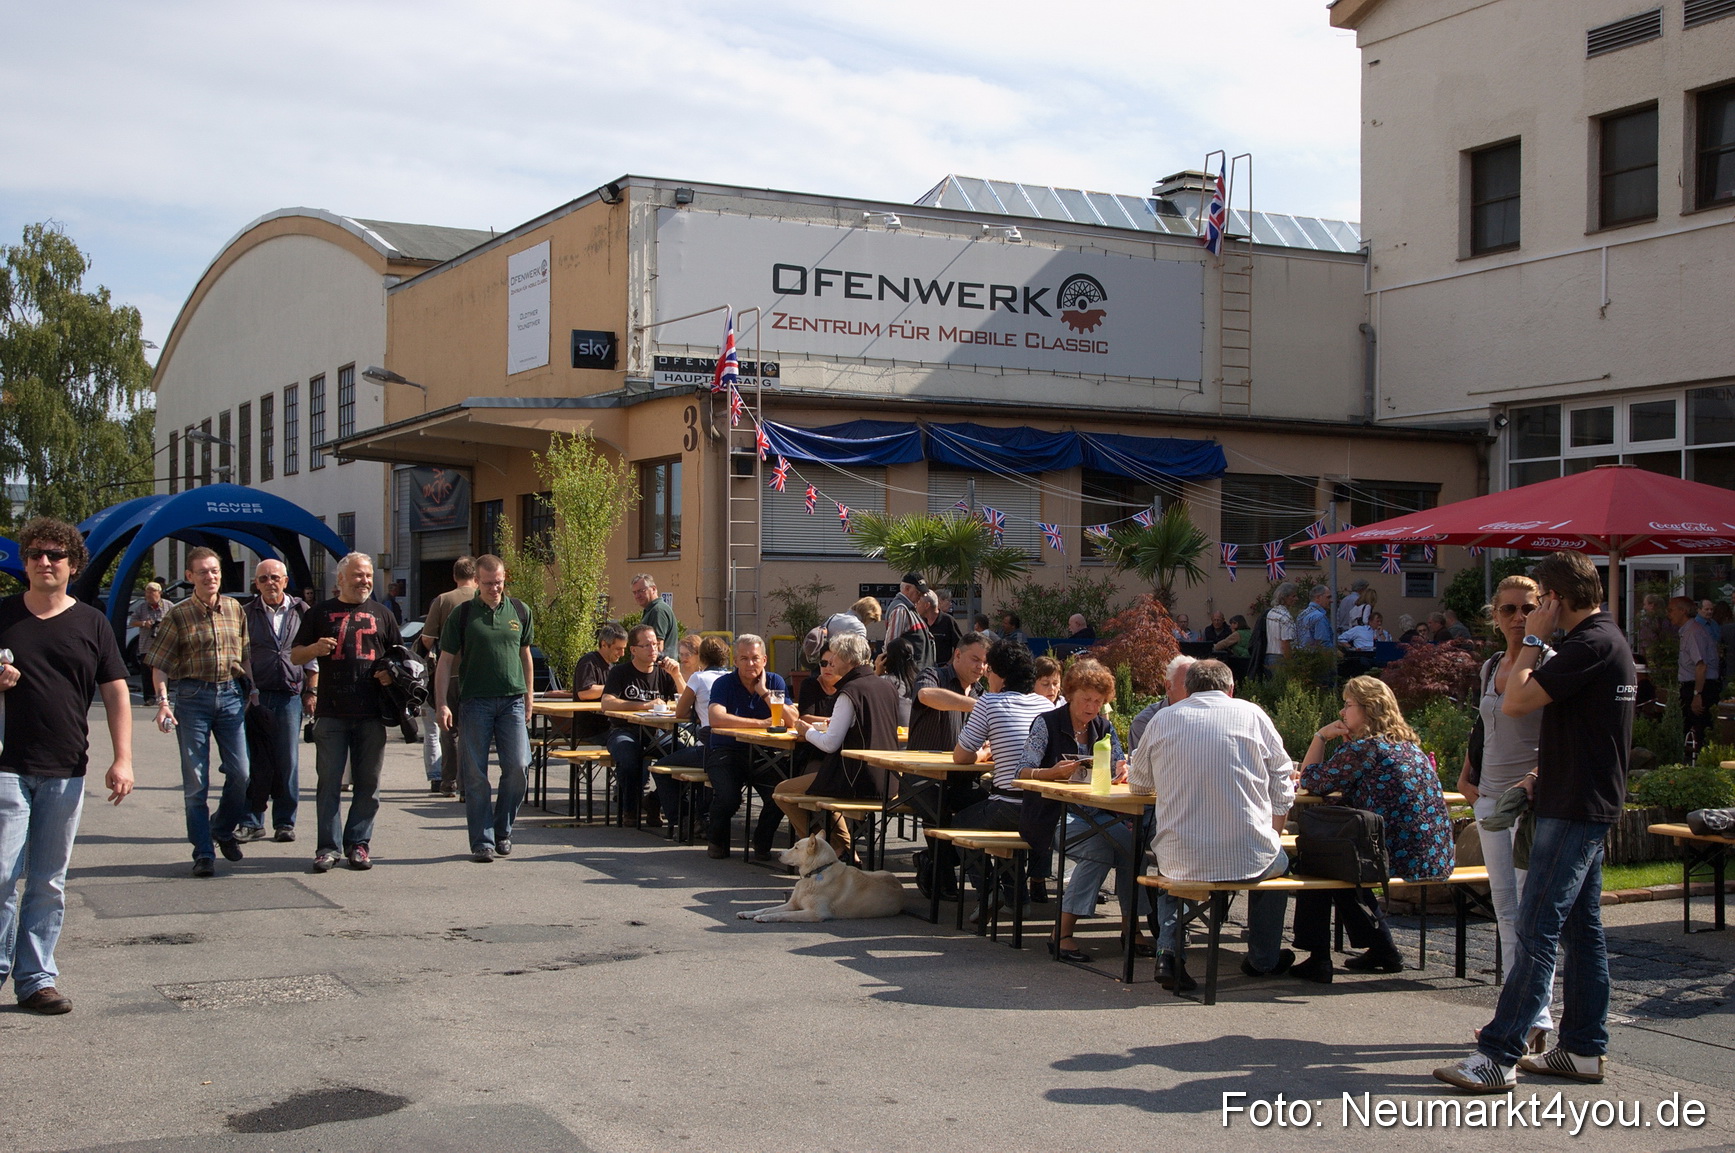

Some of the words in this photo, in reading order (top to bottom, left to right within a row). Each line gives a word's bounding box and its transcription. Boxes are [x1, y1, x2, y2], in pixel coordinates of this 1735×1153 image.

[772, 262, 1053, 318] OFENWERK
[579, 339, 610, 360] sky
[771, 312, 881, 337] ZENTRUM
[888, 320, 930, 341] FÜR
[938, 325, 1017, 348] MOBILE
[1025, 332, 1109, 355] CLASSIC
[683, 405, 699, 452] 3
[1649, 521, 1718, 532] Coca-Cola
[328, 611, 378, 660] 72
